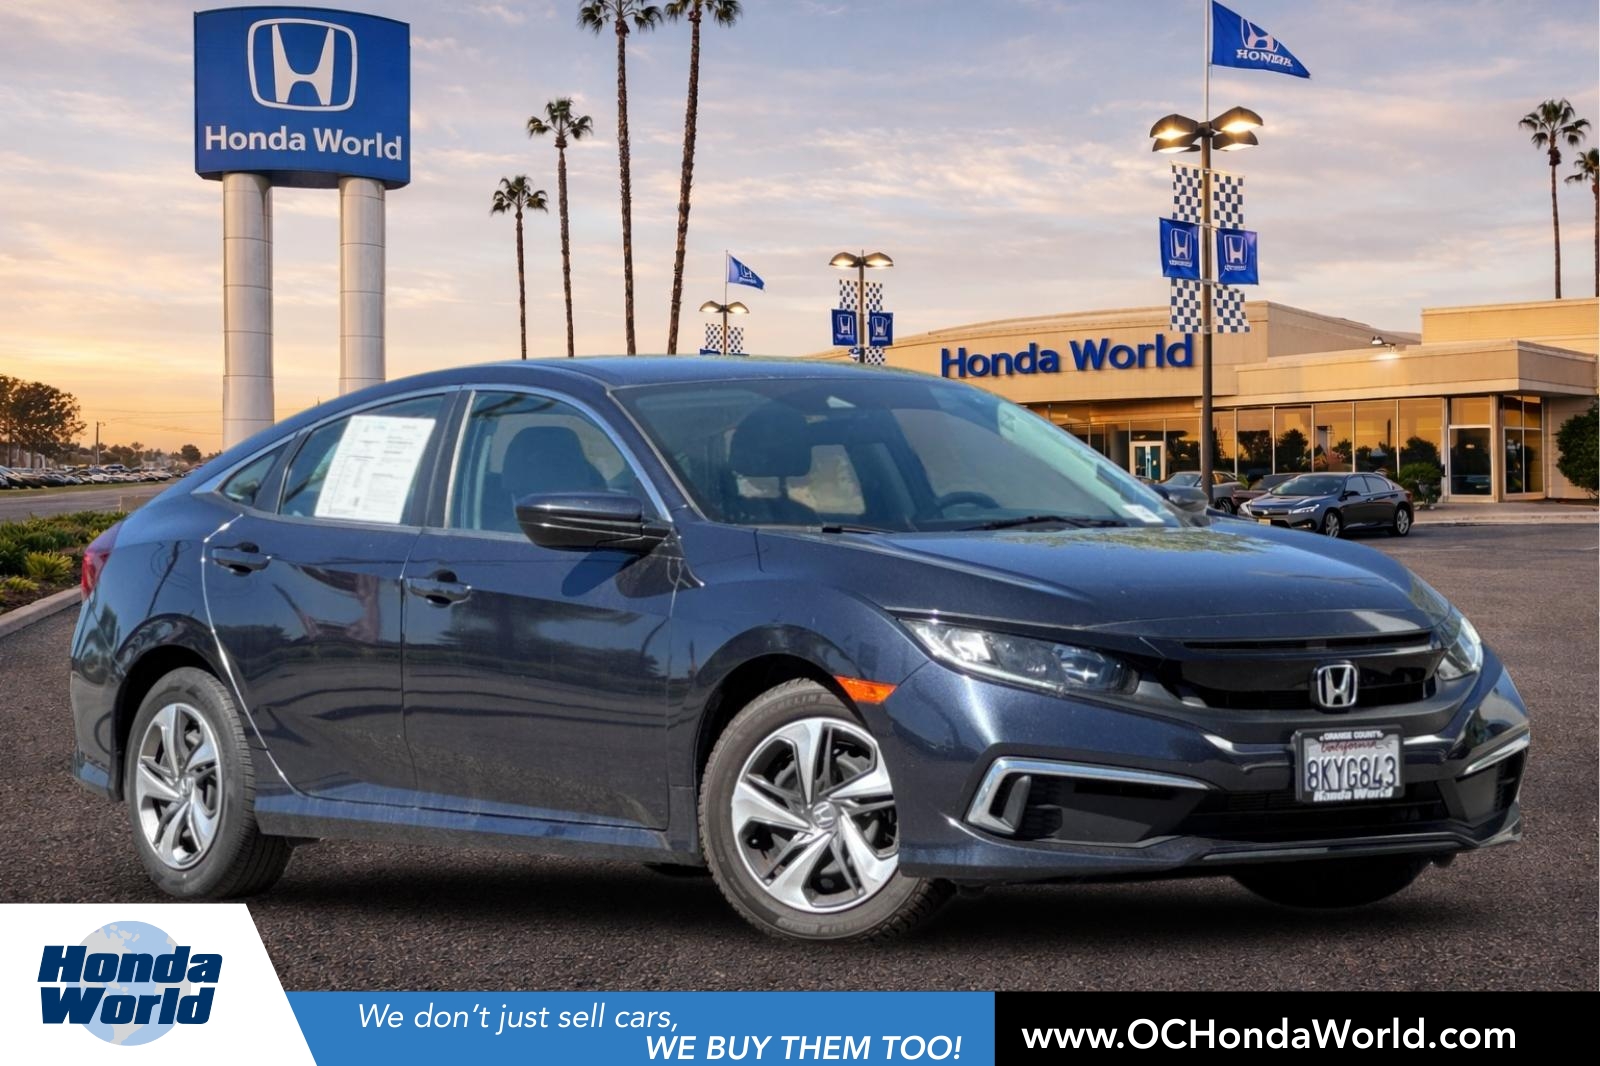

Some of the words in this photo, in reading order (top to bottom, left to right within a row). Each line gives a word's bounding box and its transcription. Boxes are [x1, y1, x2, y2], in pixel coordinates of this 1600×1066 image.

[205, 125, 306, 151] Honda
[313, 127, 402, 161] World
[941, 342, 1060, 379] Honda
[1069, 333, 1195, 372] World
[1307, 755, 1396, 792] 8KYG843
